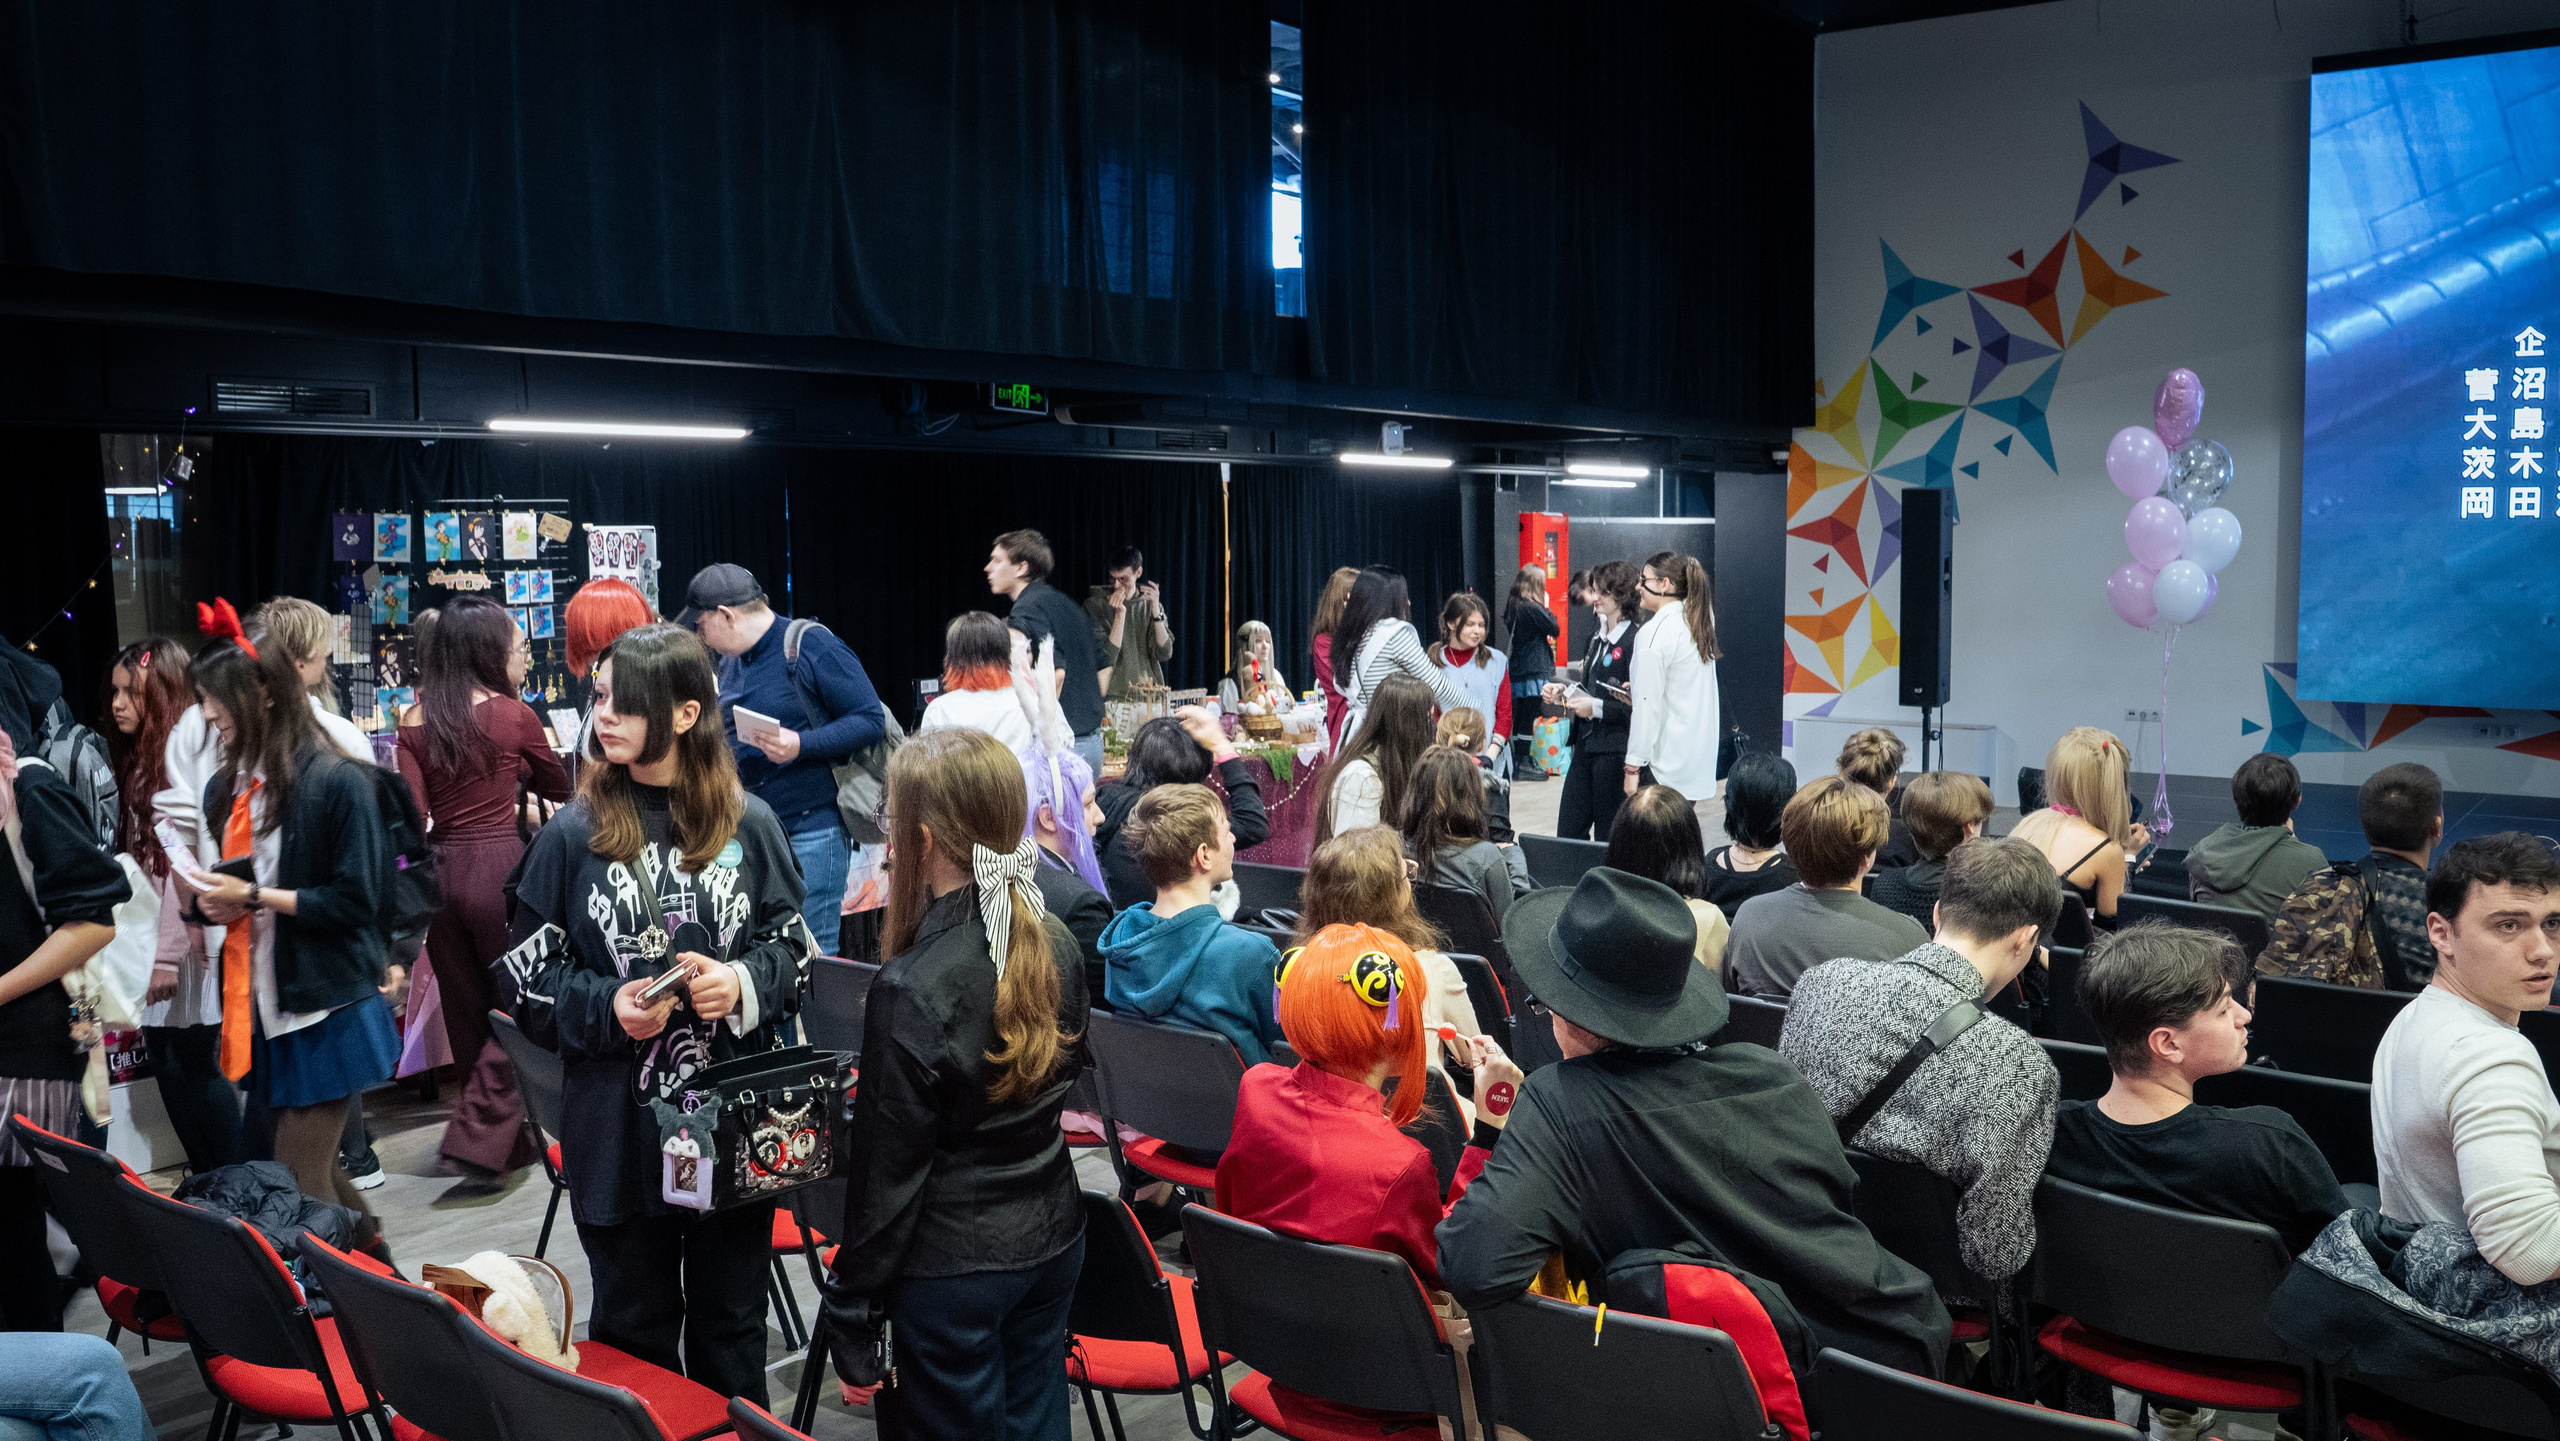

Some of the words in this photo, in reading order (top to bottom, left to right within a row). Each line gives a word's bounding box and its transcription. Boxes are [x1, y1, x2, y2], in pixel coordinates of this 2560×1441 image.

[2514, 325, 2547, 357] 企
[998, 387, 1012, 400] EXIT
[2461, 445, 2560, 480] 茨木
[2460, 486, 2560, 519] 岡田
[110, 1050, 149, 1070] 【推し
[1491, 1094, 1510, 1103] TAKEN
